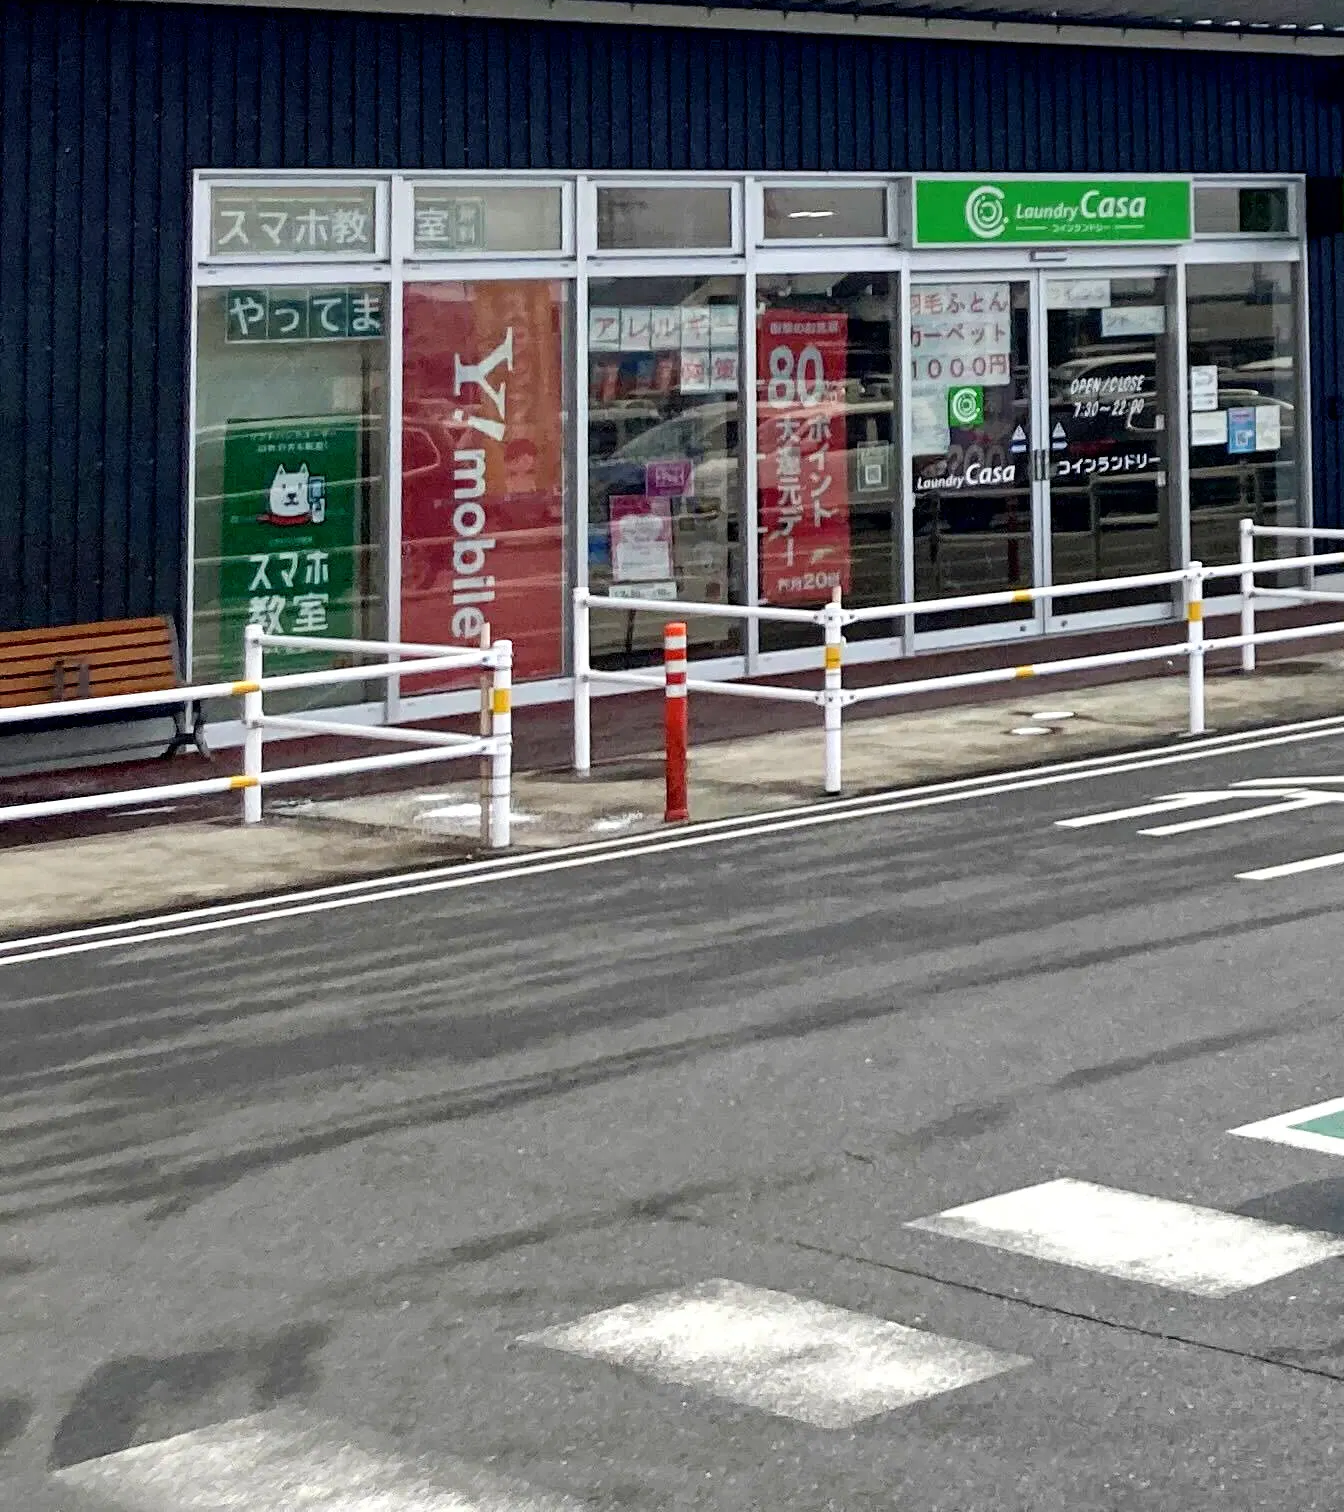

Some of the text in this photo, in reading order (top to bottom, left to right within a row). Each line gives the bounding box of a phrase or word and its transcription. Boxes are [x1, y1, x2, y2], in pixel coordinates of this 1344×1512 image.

[1016, 190, 1147, 222] Laundry Casa
[768, 345, 825, 408] 80
[917, 463, 1016, 490] Laundry Casa
[1058, 454, 1161, 476] コインランドリー
[249, 551, 329, 591] スマホ
[249, 593, 329, 635] 教室
